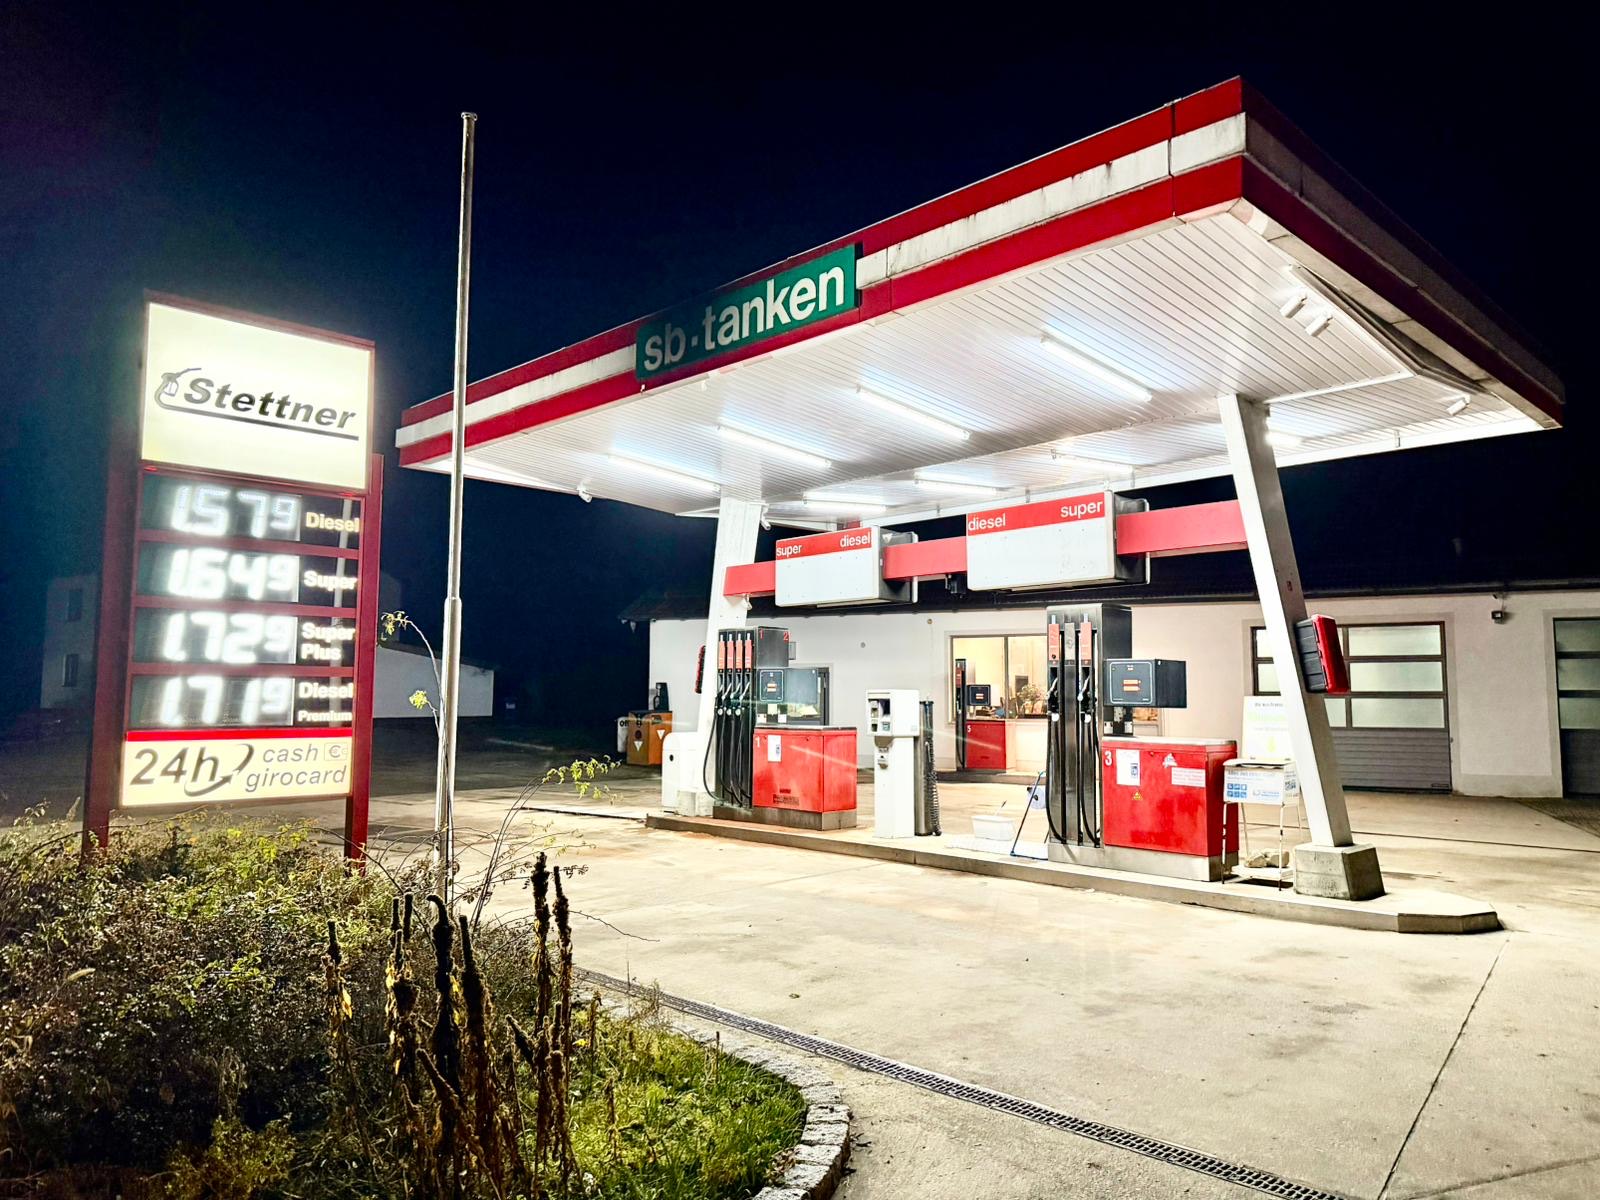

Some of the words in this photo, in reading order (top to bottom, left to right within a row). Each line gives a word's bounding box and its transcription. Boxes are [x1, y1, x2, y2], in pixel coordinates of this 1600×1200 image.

[183, 377, 356, 429] Stettner
[305, 511, 360, 533] Diesel
[967, 512, 1007, 531] diesel
[1060, 499, 1104, 518] super
[775, 543, 803, 558] super
[839, 531, 872, 549] diesel
[303, 570, 358, 591] Super
[301, 622, 356, 642] Super
[301, 643, 342, 661] Plus
[299, 681, 354, 700] Diesel
[298, 711, 353, 722] Premium
[755, 735, 760, 748] 1
[130, 745, 220, 785] 24h
[262, 743, 319, 763] cash
[1104, 750, 1113, 767] 3
[245, 765, 347, 793] girocard
